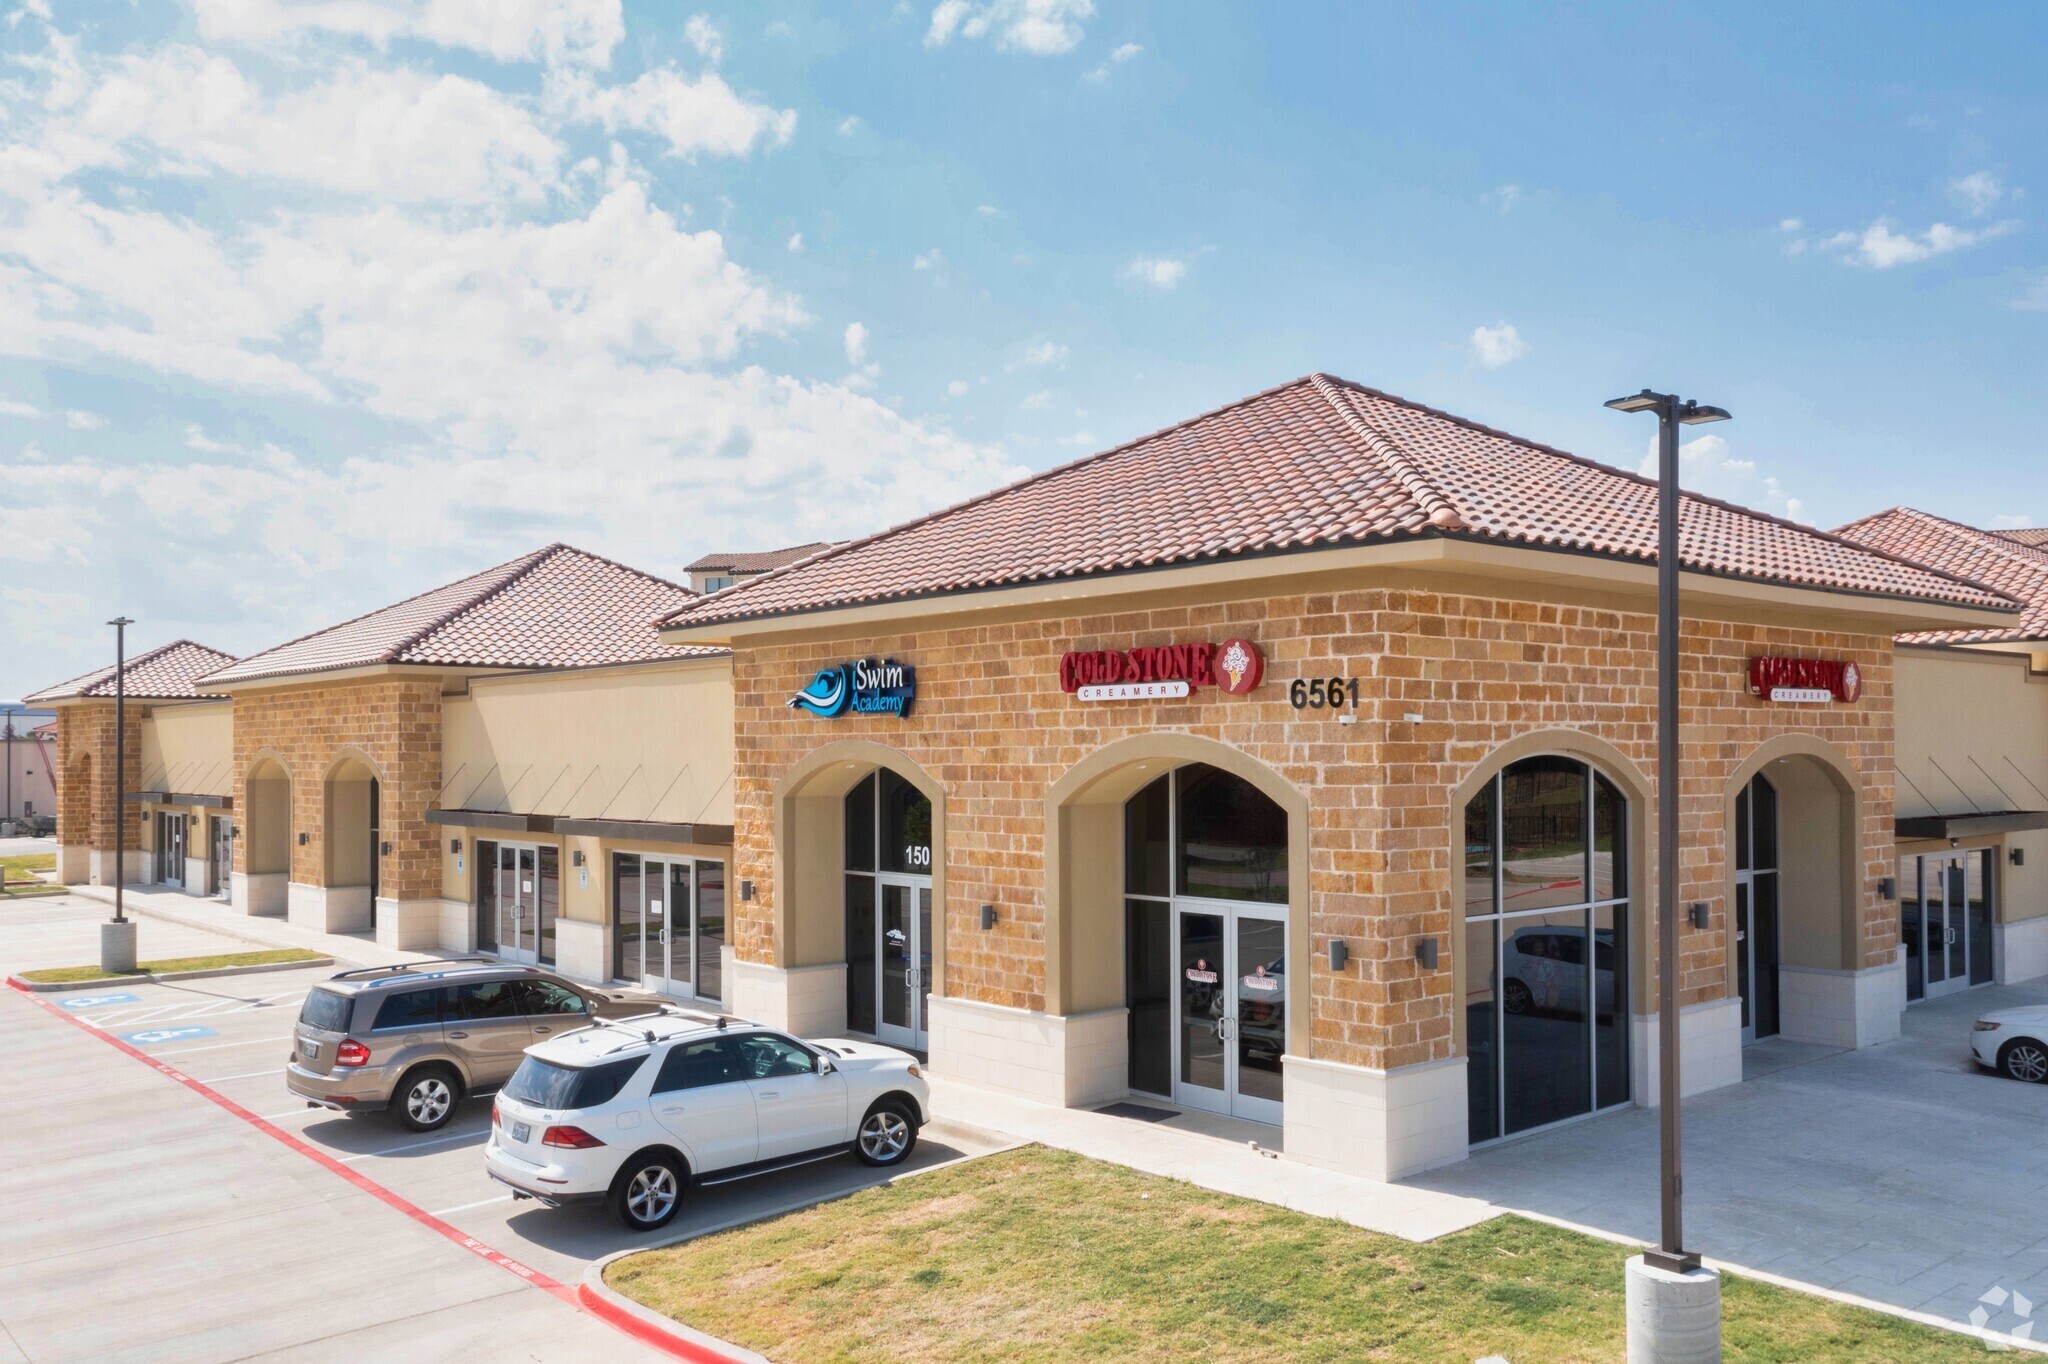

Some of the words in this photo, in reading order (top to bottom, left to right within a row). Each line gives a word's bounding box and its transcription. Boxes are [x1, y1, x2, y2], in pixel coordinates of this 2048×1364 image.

[1060, 651, 1120, 693] COLD
[1124, 643, 1212, 686] STONE
[851, 688, 904, 718] Academy
[1083, 685, 1180, 698] CREAMERY
[1290, 677, 1359, 710] 6561
[1774, 691, 1828, 699] CREAMERY
[905, 844, 931, 866] 150
